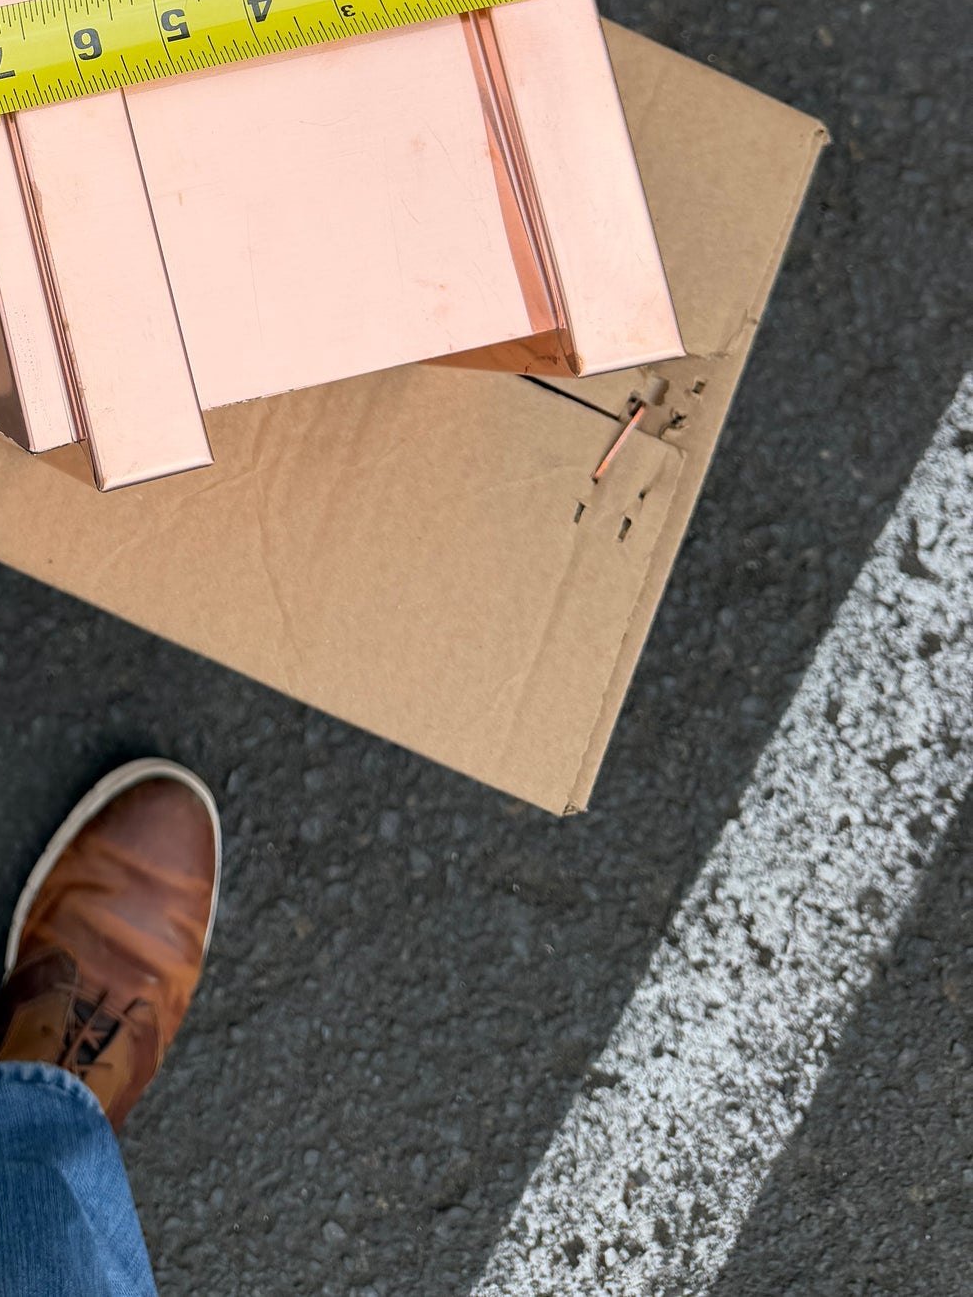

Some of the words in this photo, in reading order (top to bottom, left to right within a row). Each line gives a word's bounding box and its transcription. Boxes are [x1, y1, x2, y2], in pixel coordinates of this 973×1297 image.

[160, 8, 191, 43] 5
[341, 4, 356, 18] 3
[73, 28, 103, 61] 6
